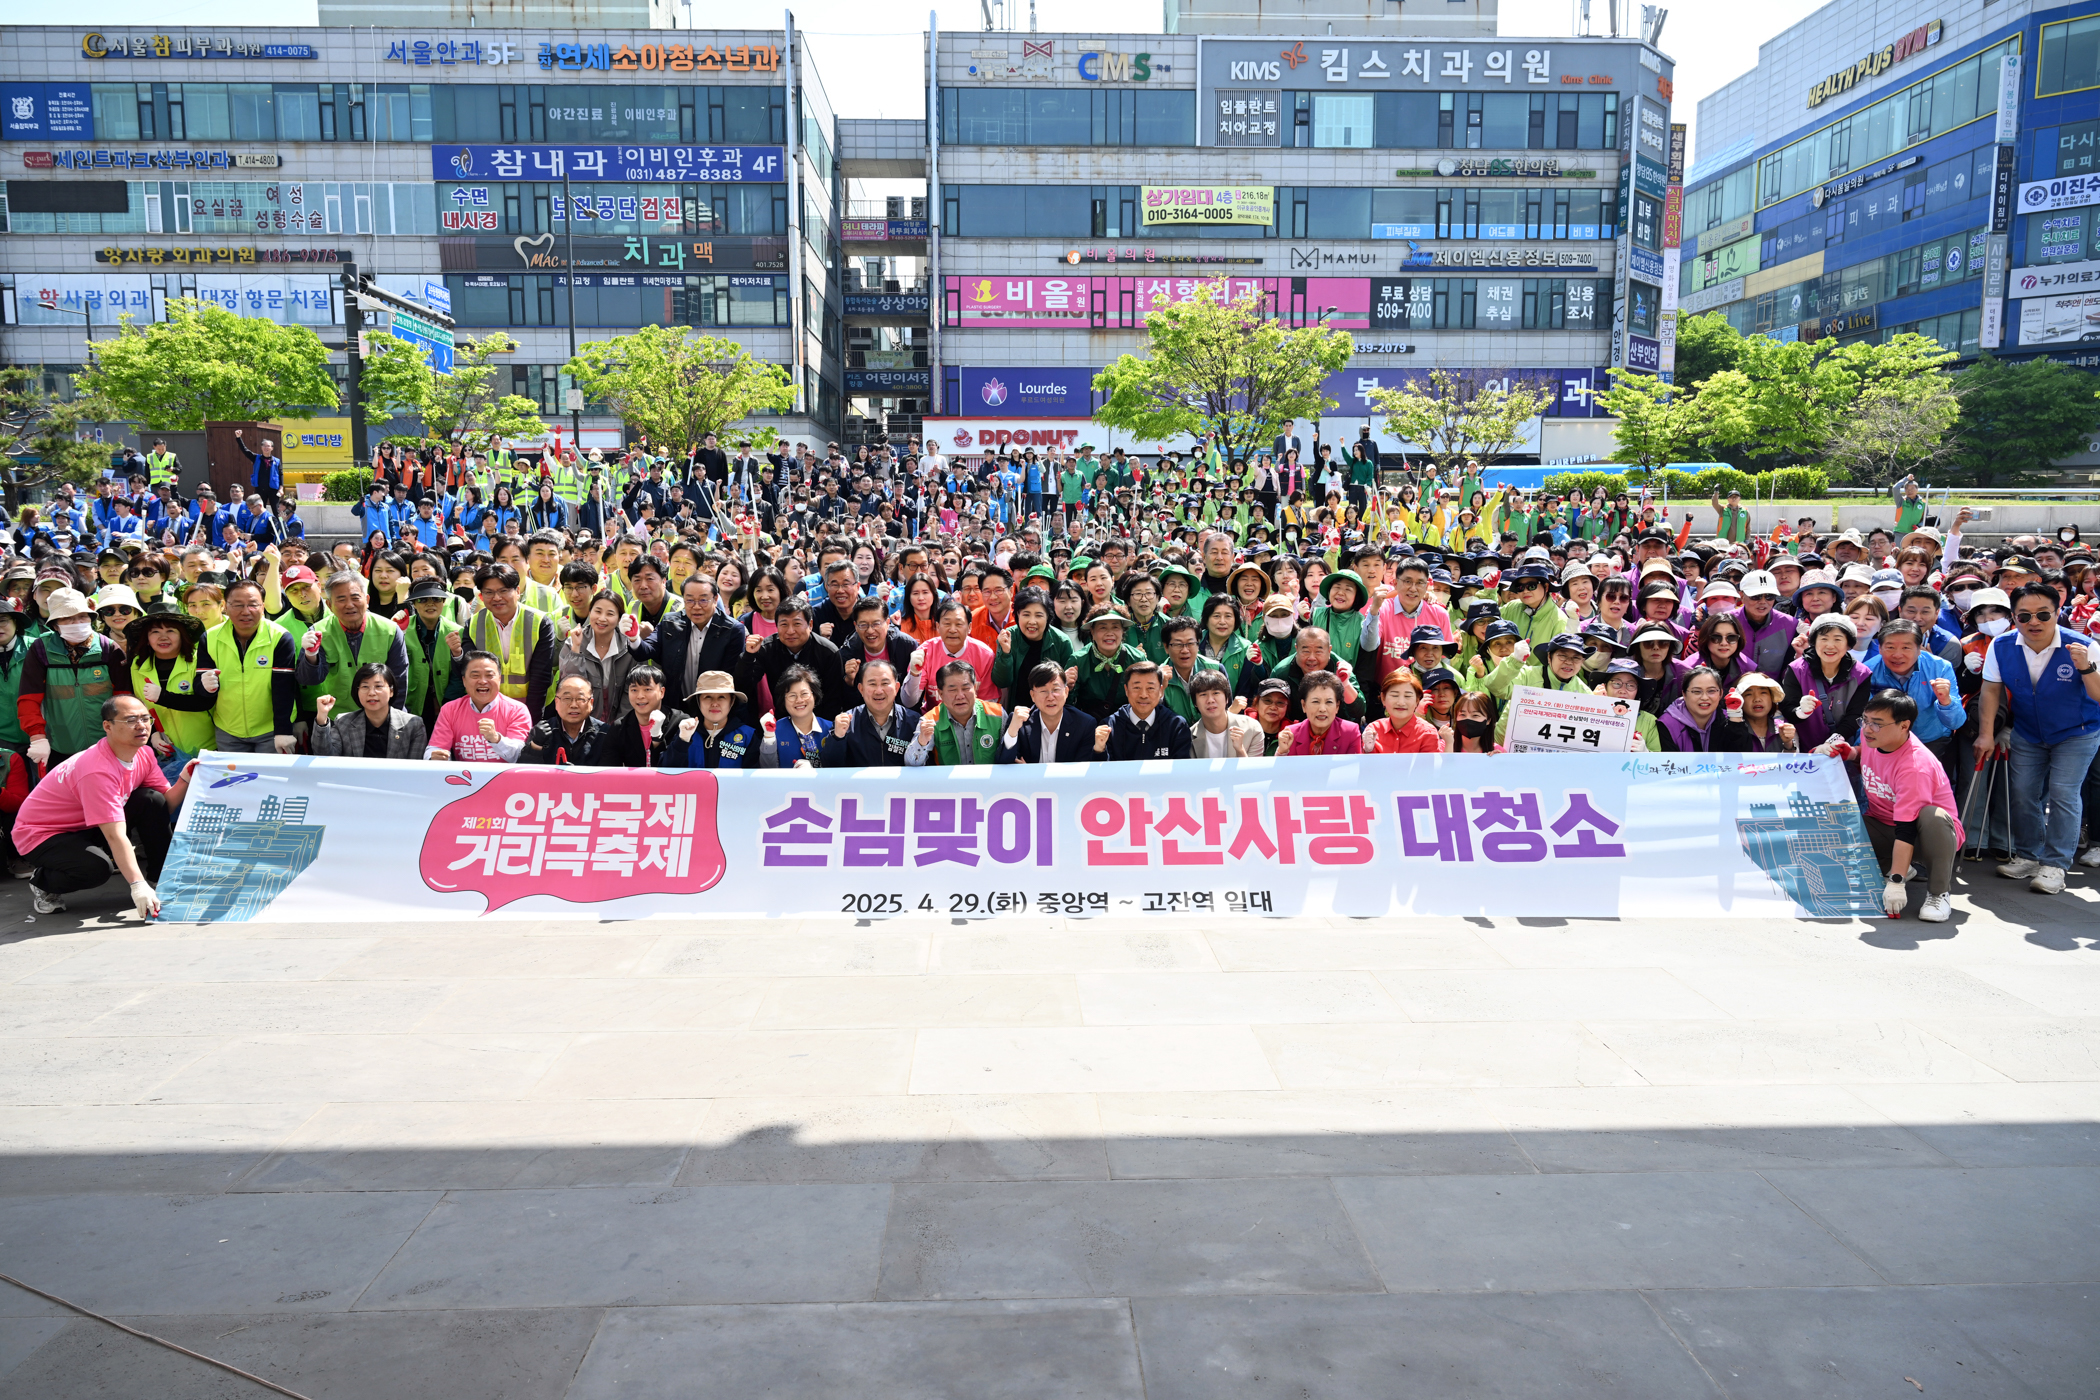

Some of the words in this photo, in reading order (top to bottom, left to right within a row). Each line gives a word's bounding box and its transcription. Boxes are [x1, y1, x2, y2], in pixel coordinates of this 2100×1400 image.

[266, 46, 309, 56] 414-0075
[387, 40, 483, 66] 서울안과
[487, 42, 517, 65] 5F
[612, 44, 780, 72] 소아청소년과
[1078, 53, 1151, 81] CMS
[1230, 61, 1281, 81] KIMS
[1319, 48, 1550, 83] 킴스치과의원
[1807, 65, 1856, 109] HEALTH
[1856, 45, 1893, 82] PLUS
[1894, 23, 1930, 62] GYM
[1561, 75, 1584, 84] Kims
[1589, 75, 1613, 84] Clinic
[549, 107, 603, 121] 야간진료
[624, 108, 677, 121] 이비인후과
[1220, 100, 1277, 115] 임플란트
[1220, 120, 1277, 136] 치아교정
[238, 155, 276, 166] T.414-4800
[490, 149, 608, 177] 참내과
[625, 147, 744, 168] 이비인후과
[752, 156, 777, 174] 4F
[655, 168, 743, 181] 487-8383
[450, 187, 490, 207] 수면
[1146, 189, 1214, 207] 상가임대
[1216, 190, 1233, 205] 4층
[442, 210, 499, 231] 내시경
[1148, 208, 1233, 222] 010-3164-0005
[1386, 227, 1421, 237] 피부질환
[1488, 227, 1516, 237] 여드름
[262, 248, 338, 263] 486-9975
[530, 253, 559, 268] MAC
[1324, 254, 1376, 264] MAMUI
[1434, 249, 1557, 268] 제이엠신용정보
[1560, 253, 1592, 265] 509-7400
[755, 261, 784, 269] 401.7528
[1705, 258, 1718, 279] 5F
[603, 276, 635, 286] 임플란트
[731, 276, 771, 286] 레이저치료
[108, 288, 150, 310] 외과
[1006, 280, 1073, 309] 비올
[1076, 283, 1086, 308] 의원
[1136, 280, 1144, 309] 진료과목
[1381, 285, 1404, 301] 무료
[1408, 284, 1433, 301] 상담
[1487, 285, 1514, 302] 채권
[1568, 285, 1595, 302] 신용
[1377, 302, 1432, 319] 509-7400
[1485, 305, 1512, 321] 추심
[1567, 305, 1594, 321] 조사
[1848, 313, 1871, 330] Live
[1630, 342, 1658, 366] 산부인과
[1019, 382, 1067, 396] Lourdes
[301, 433, 343, 448] 빽다방
[978, 429, 1079, 446] DDONUT
[1549, 453, 1597, 466] PURPAPA
[1785, 759, 1820, 775] 안산
[503, 792, 697, 835] 안산국제
[461, 815, 506, 831] 제21회
[762, 797, 1053, 868] 손님맞이
[1080, 795, 1376, 866] 안산사랑
[1397, 791, 1627, 863] 대청소
[447, 834, 694, 878] 거리극축제
[841, 892, 908, 914] 2025.
[918, 893, 939, 914] 4.
[1036, 890, 1110, 914] 중앙역
[1142, 890, 1215, 914] 고잔역
[1225, 889, 1273, 913] 일대
